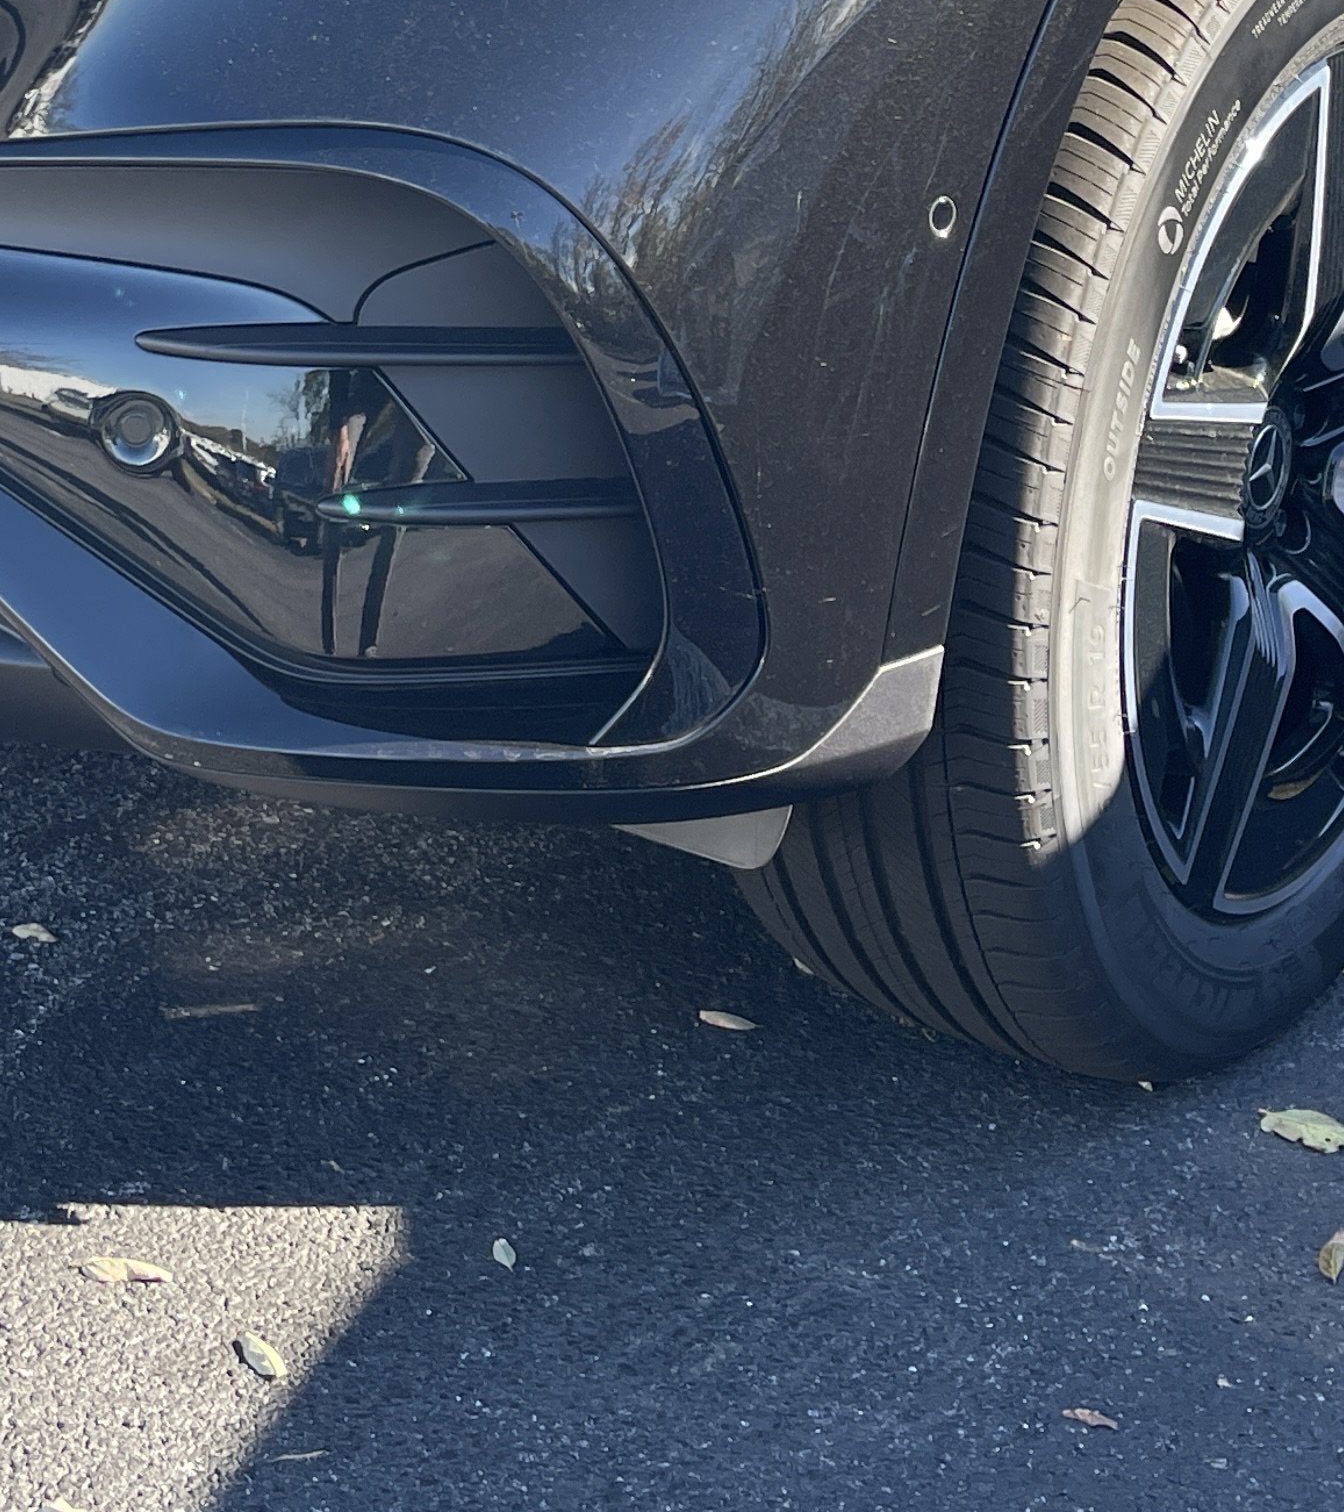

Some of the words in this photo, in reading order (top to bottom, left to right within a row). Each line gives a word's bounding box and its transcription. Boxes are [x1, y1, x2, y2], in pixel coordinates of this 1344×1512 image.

[1174, 108, 1221, 203] MICHELIN
[1180, 179, 1200, 217] Total
[1196, 99, 1241, 184] Performance
[1103, 337, 1141, 481] OUTSIDE
